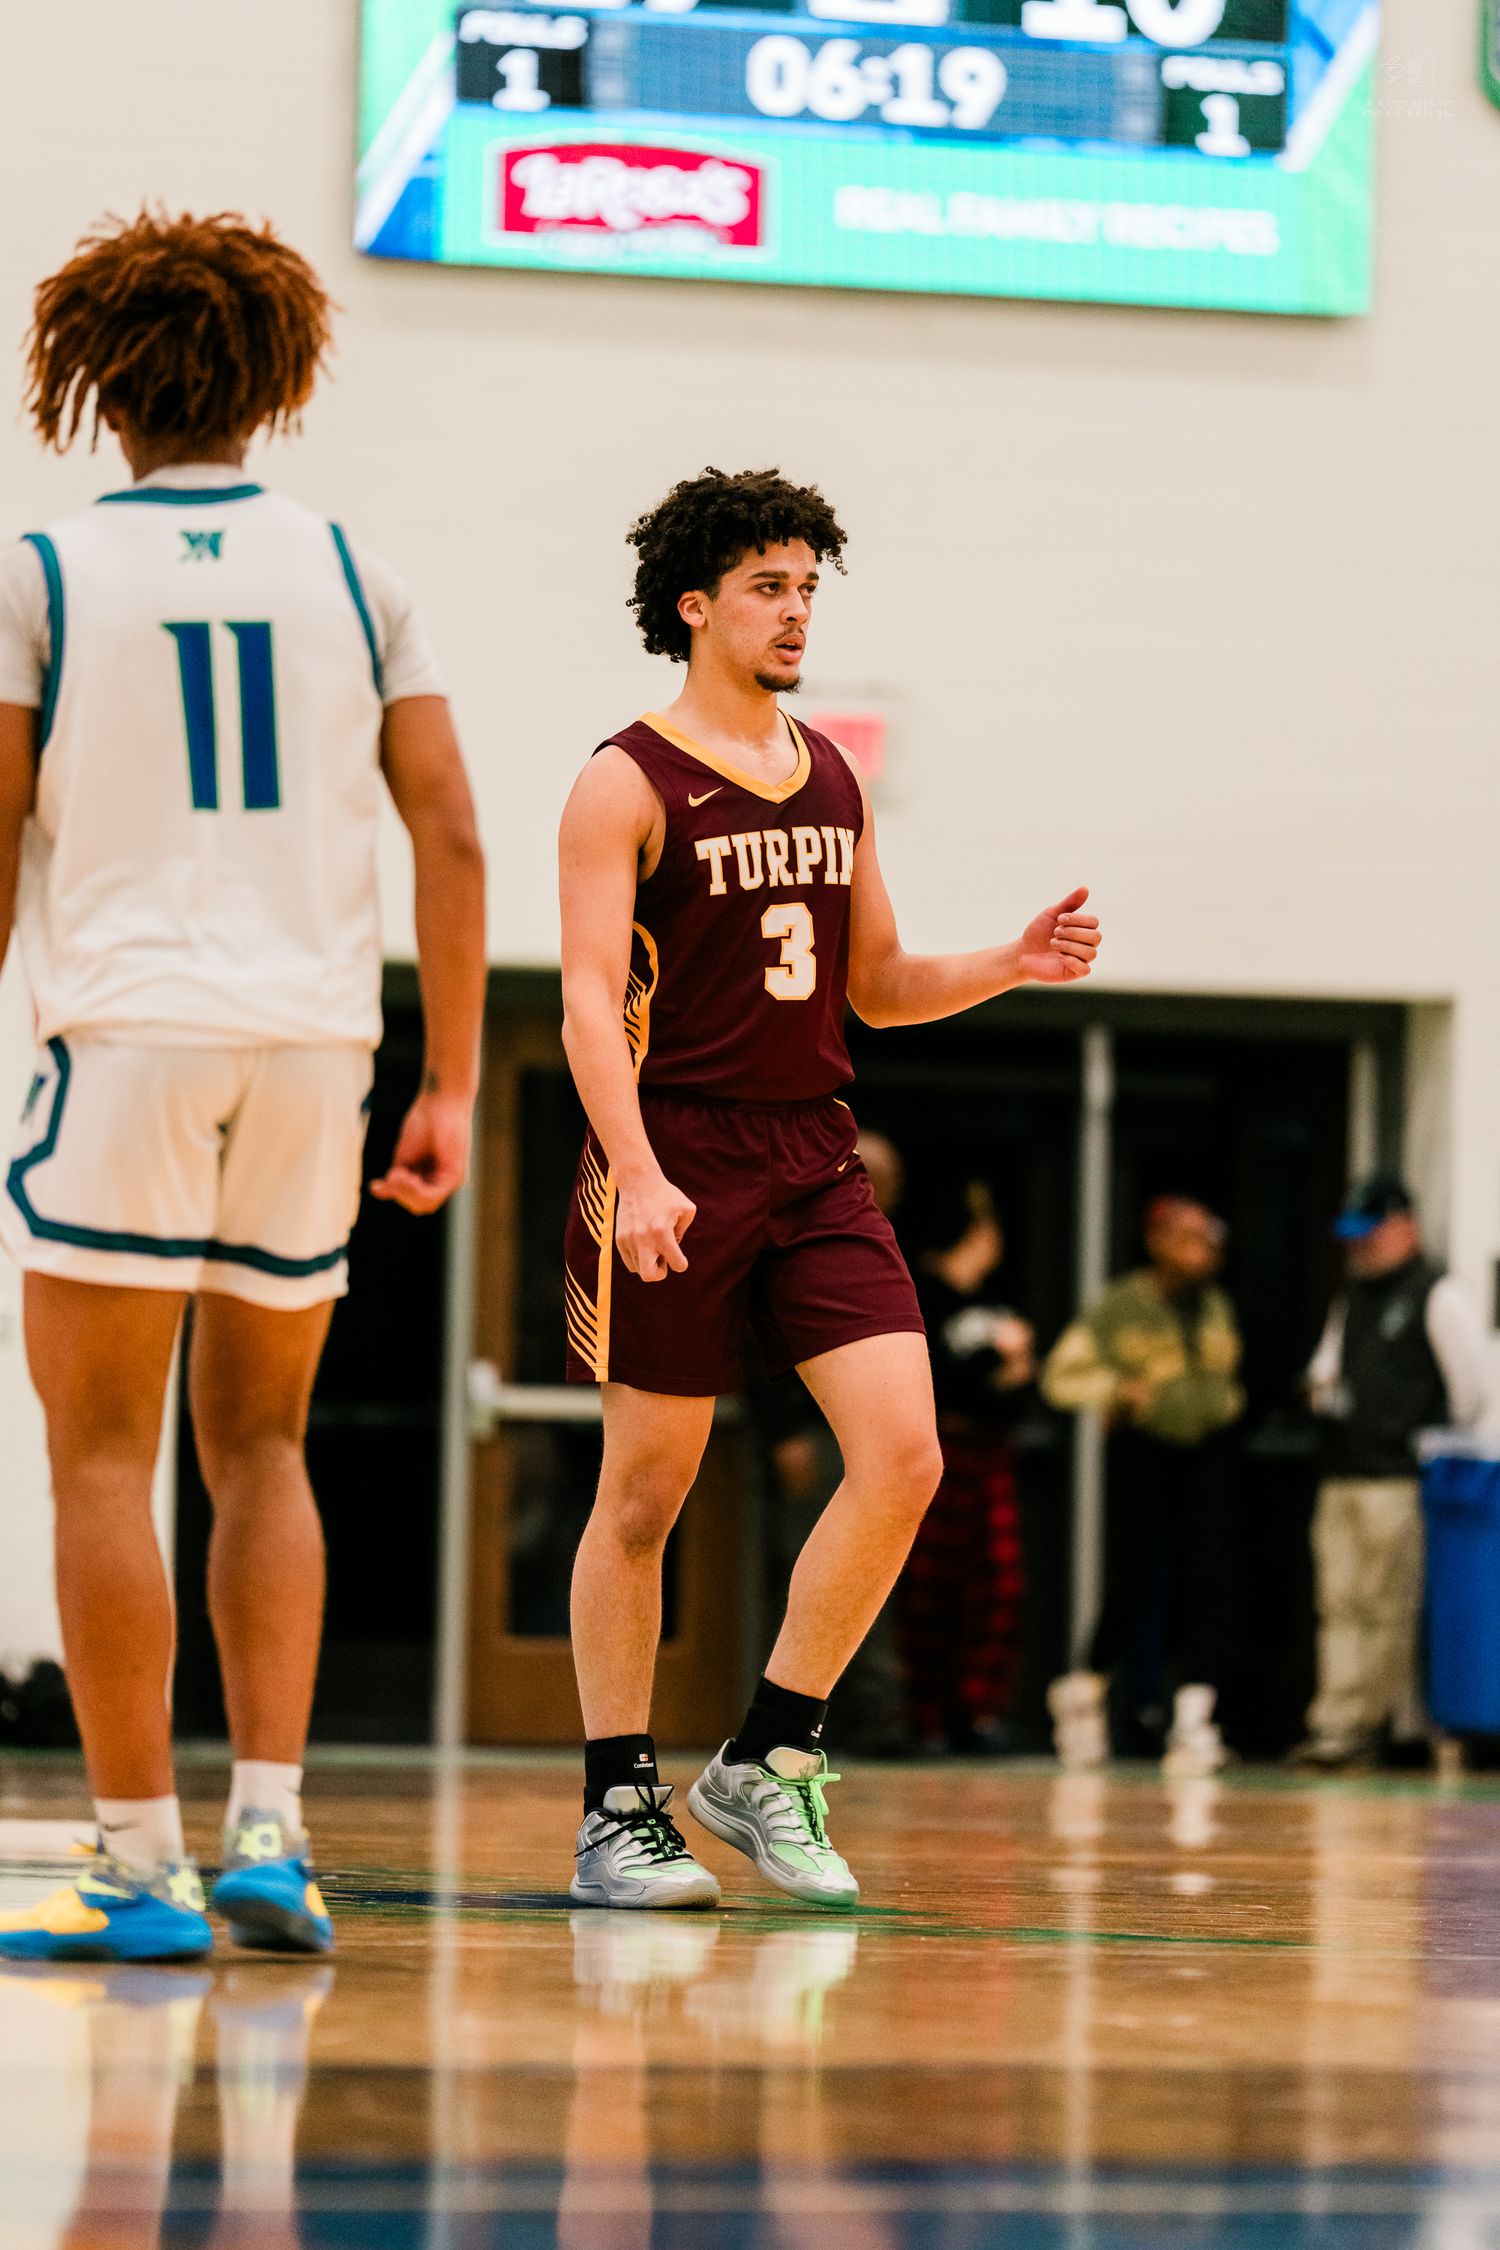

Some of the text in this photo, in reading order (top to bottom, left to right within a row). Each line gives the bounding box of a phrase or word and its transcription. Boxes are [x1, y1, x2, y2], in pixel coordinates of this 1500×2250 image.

[492, 48, 551, 112] 1
[745, 35, 1008, 130] 06:19
[1195, 93, 1251, 157] 1
[161, 620, 281, 812] 11
[694, 825, 855, 896] TURPIN
[760, 902, 817, 1001] 3
